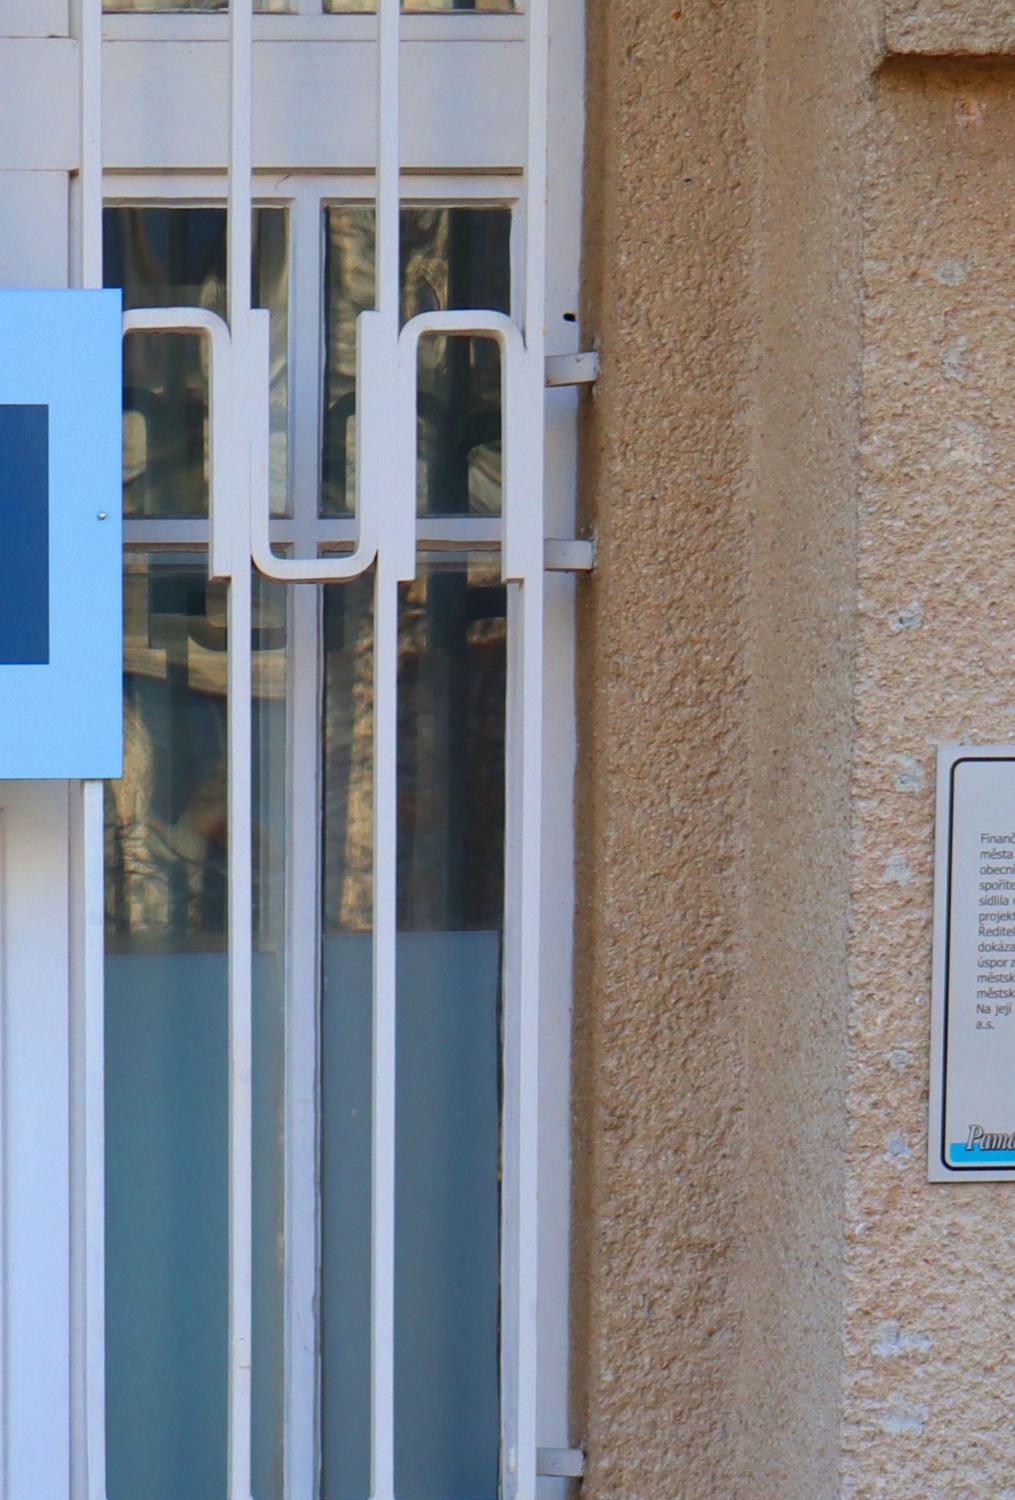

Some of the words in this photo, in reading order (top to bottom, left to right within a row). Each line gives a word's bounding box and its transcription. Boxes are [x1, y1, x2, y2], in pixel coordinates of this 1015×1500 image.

[979, 848, 1013, 860] města
[978, 894, 1009, 906] sídlila
[977, 956, 1008, 969] úspor
[976, 1003, 991, 1014] Na
[995, 1002, 1012, 1016] její
[976, 1020, 995, 1030] a.s.
